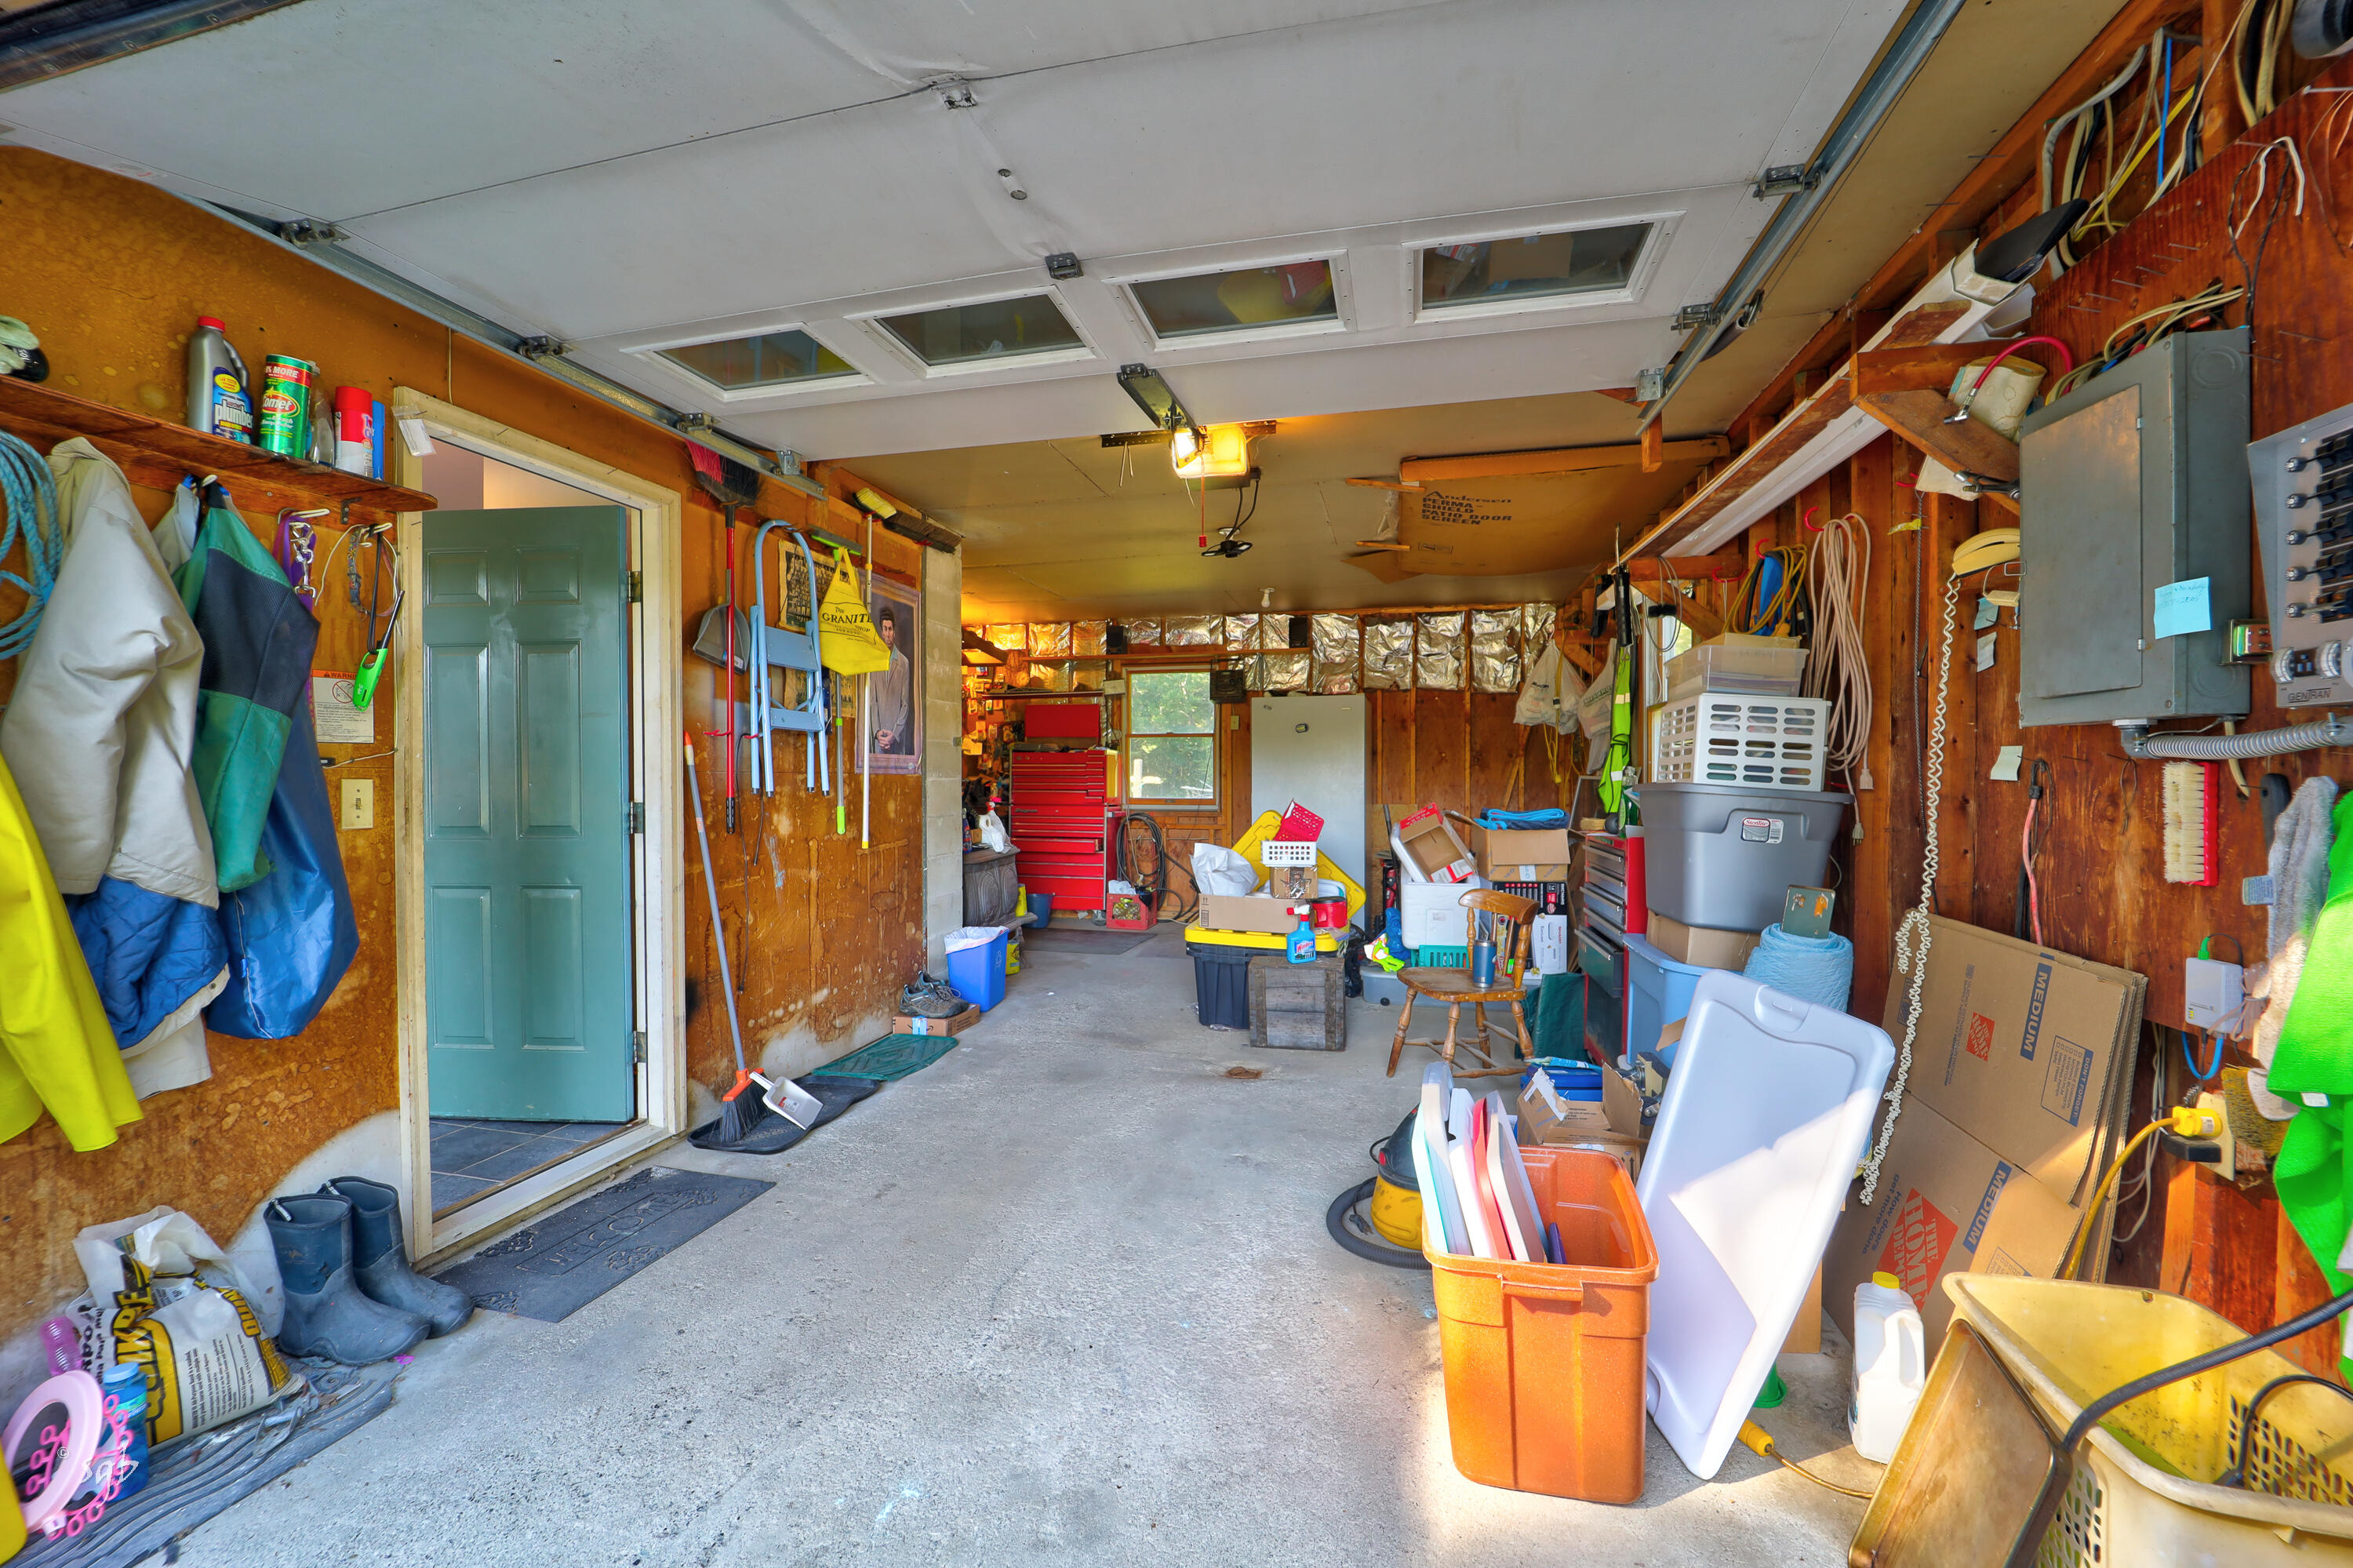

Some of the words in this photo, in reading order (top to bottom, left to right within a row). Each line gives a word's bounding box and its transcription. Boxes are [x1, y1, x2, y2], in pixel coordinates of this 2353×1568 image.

[272, 366, 299, 378] MORE
[1422, 503, 1474, 513] SHIELD
[1425, 490, 1511, 503] Andersen
[1421, 508, 1463, 518] PATIO
[1421, 514, 1482, 525] SCREEN
[2024, 971, 2048, 1053] MEDIUM
[1973, 1014, 1989, 1057] HOME
[2081, 1057, 2090, 1082] DON'T
[1889, 1173, 1900, 1196] get
[1875, 1197, 1891, 1224] more
[1889, 1191, 1902, 1217] How
[1969, 1169, 2006, 1245] MEDIUM
[546, 1194, 679, 1267] WELCOME
[1862, 1226, 1878, 1255] done
[1871, 1218, 1890, 1252] doors
[1925, 1217, 1939, 1263] THE
[1904, 1195, 1929, 1302] HOME
